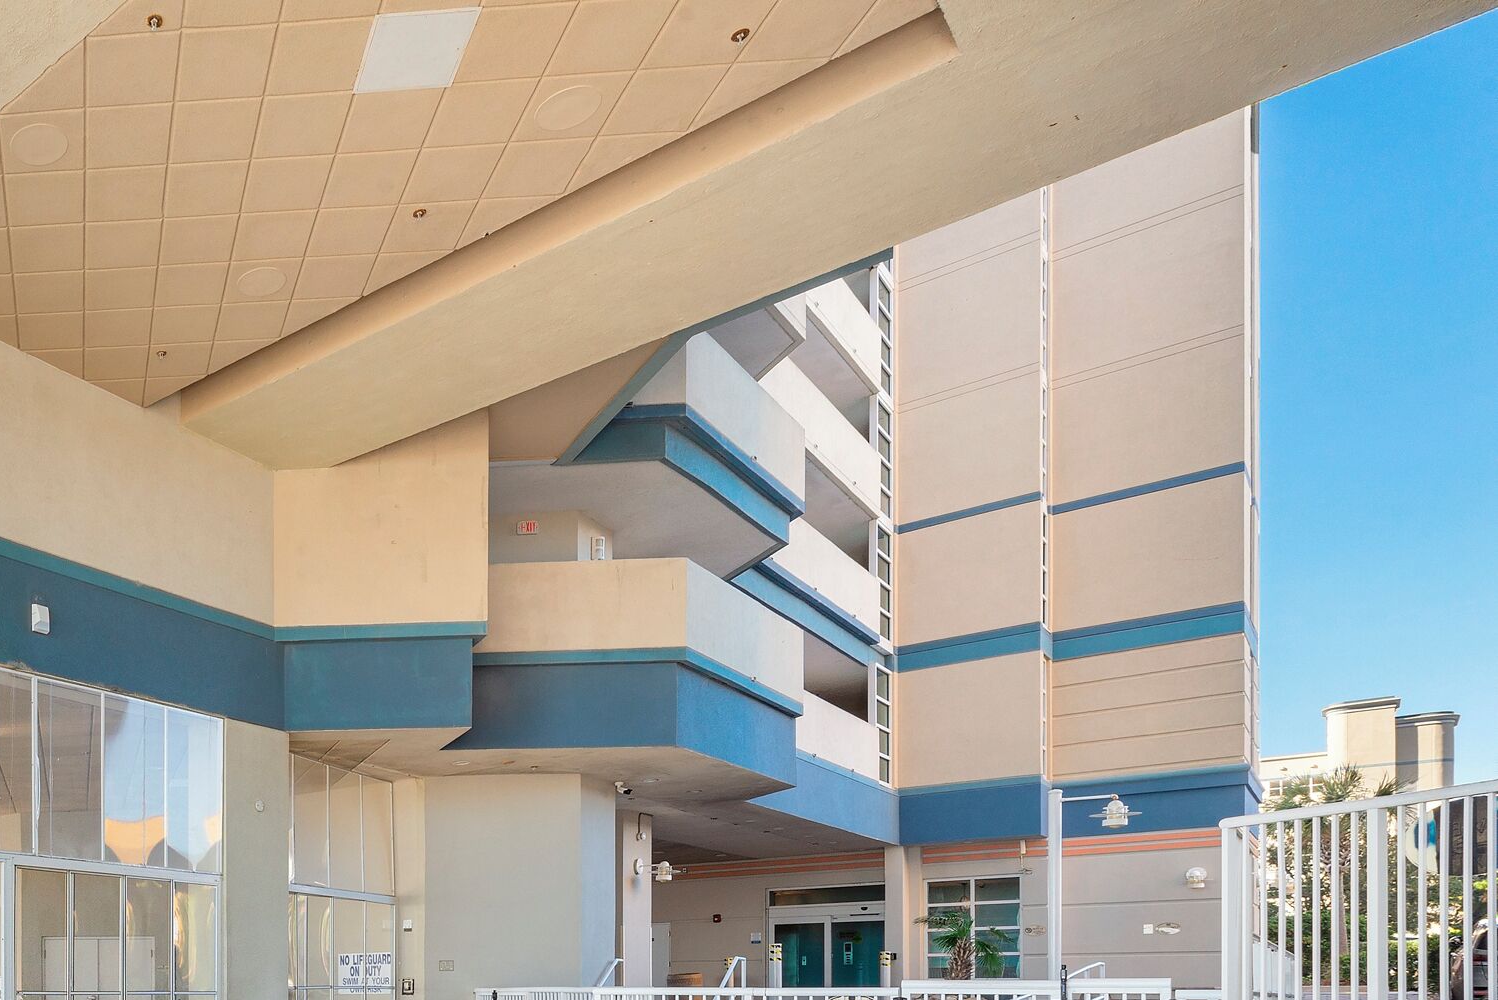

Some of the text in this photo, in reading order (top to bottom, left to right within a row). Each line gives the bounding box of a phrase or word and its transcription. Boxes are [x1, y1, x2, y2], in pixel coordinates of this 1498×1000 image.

[340, 955, 350, 966] NO
[350, 966, 360, 977] ON
[372, 977, 390, 985] YOUR
